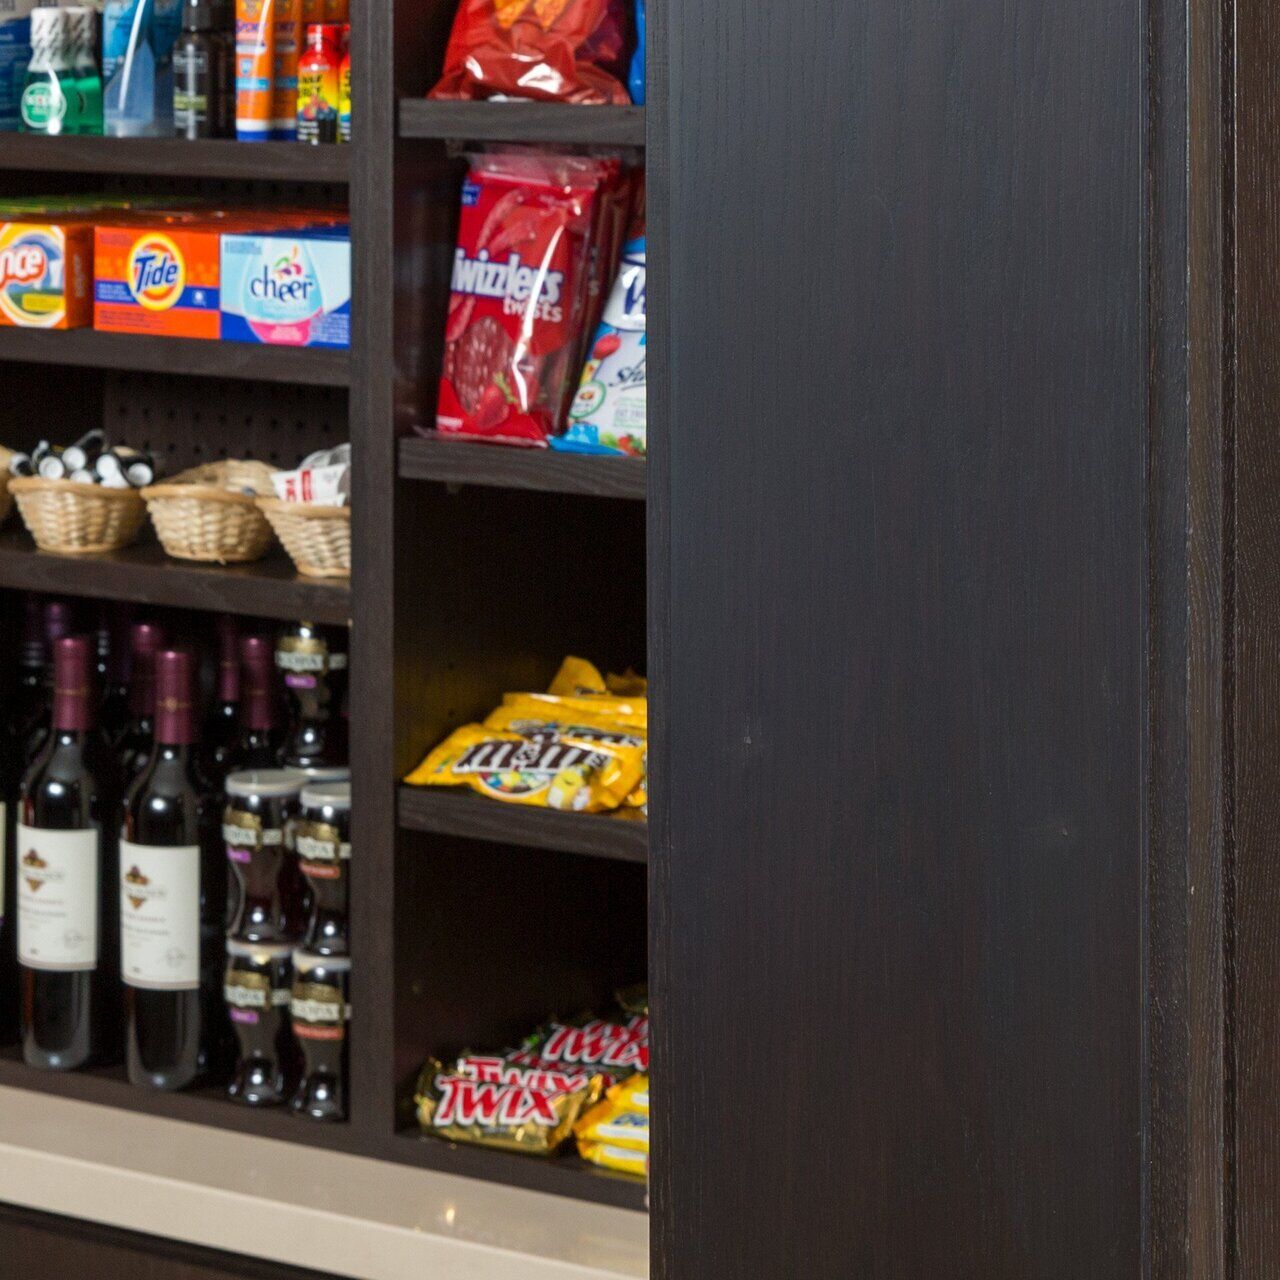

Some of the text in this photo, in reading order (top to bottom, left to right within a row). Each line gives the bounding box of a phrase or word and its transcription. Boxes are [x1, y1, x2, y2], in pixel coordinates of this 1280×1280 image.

[135, 255, 178, 293] Tide
[250, 265, 313, 303] cheer
[503, 297, 563, 323] twsts
[435, 1075, 559, 1126] TWIX
